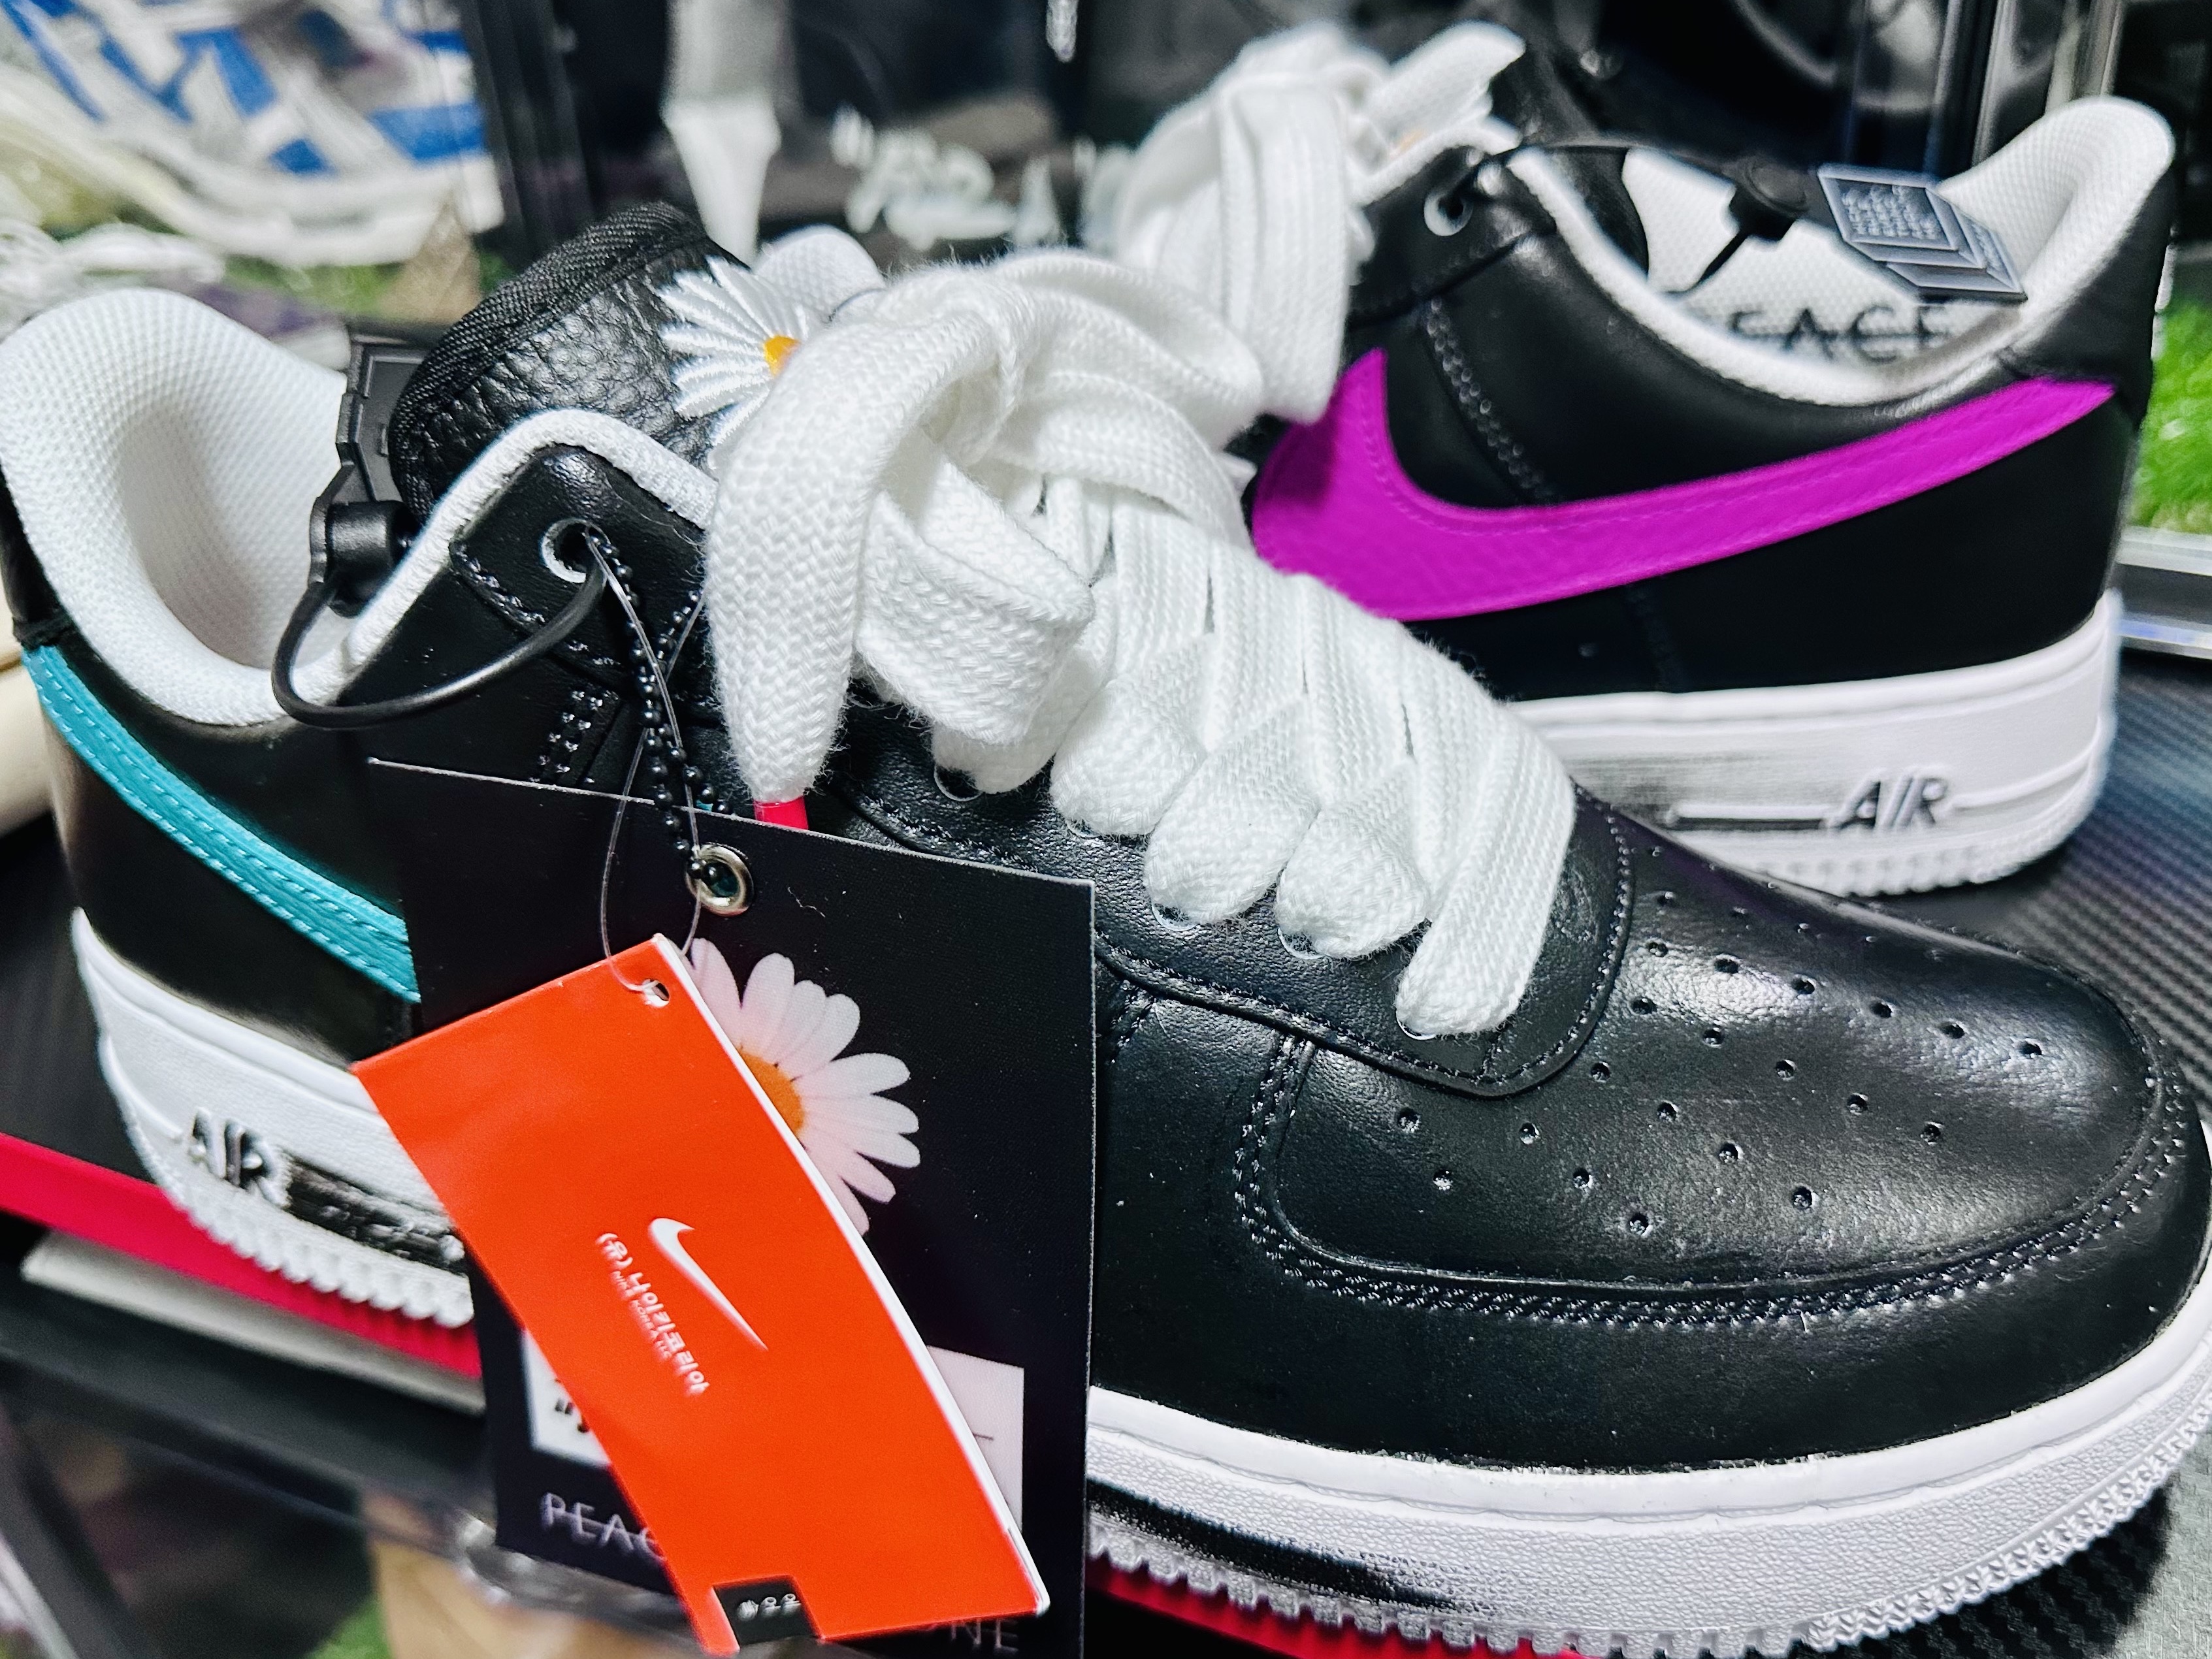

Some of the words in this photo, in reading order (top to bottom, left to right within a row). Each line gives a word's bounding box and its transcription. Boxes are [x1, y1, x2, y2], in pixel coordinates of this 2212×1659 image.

[1833, 773, 1948, 830] AIR
[189, 1108, 289, 1208] AIR
[595, 1232, 633, 1270] (유)
[626, 1271, 710, 1396] 나이키코리아
